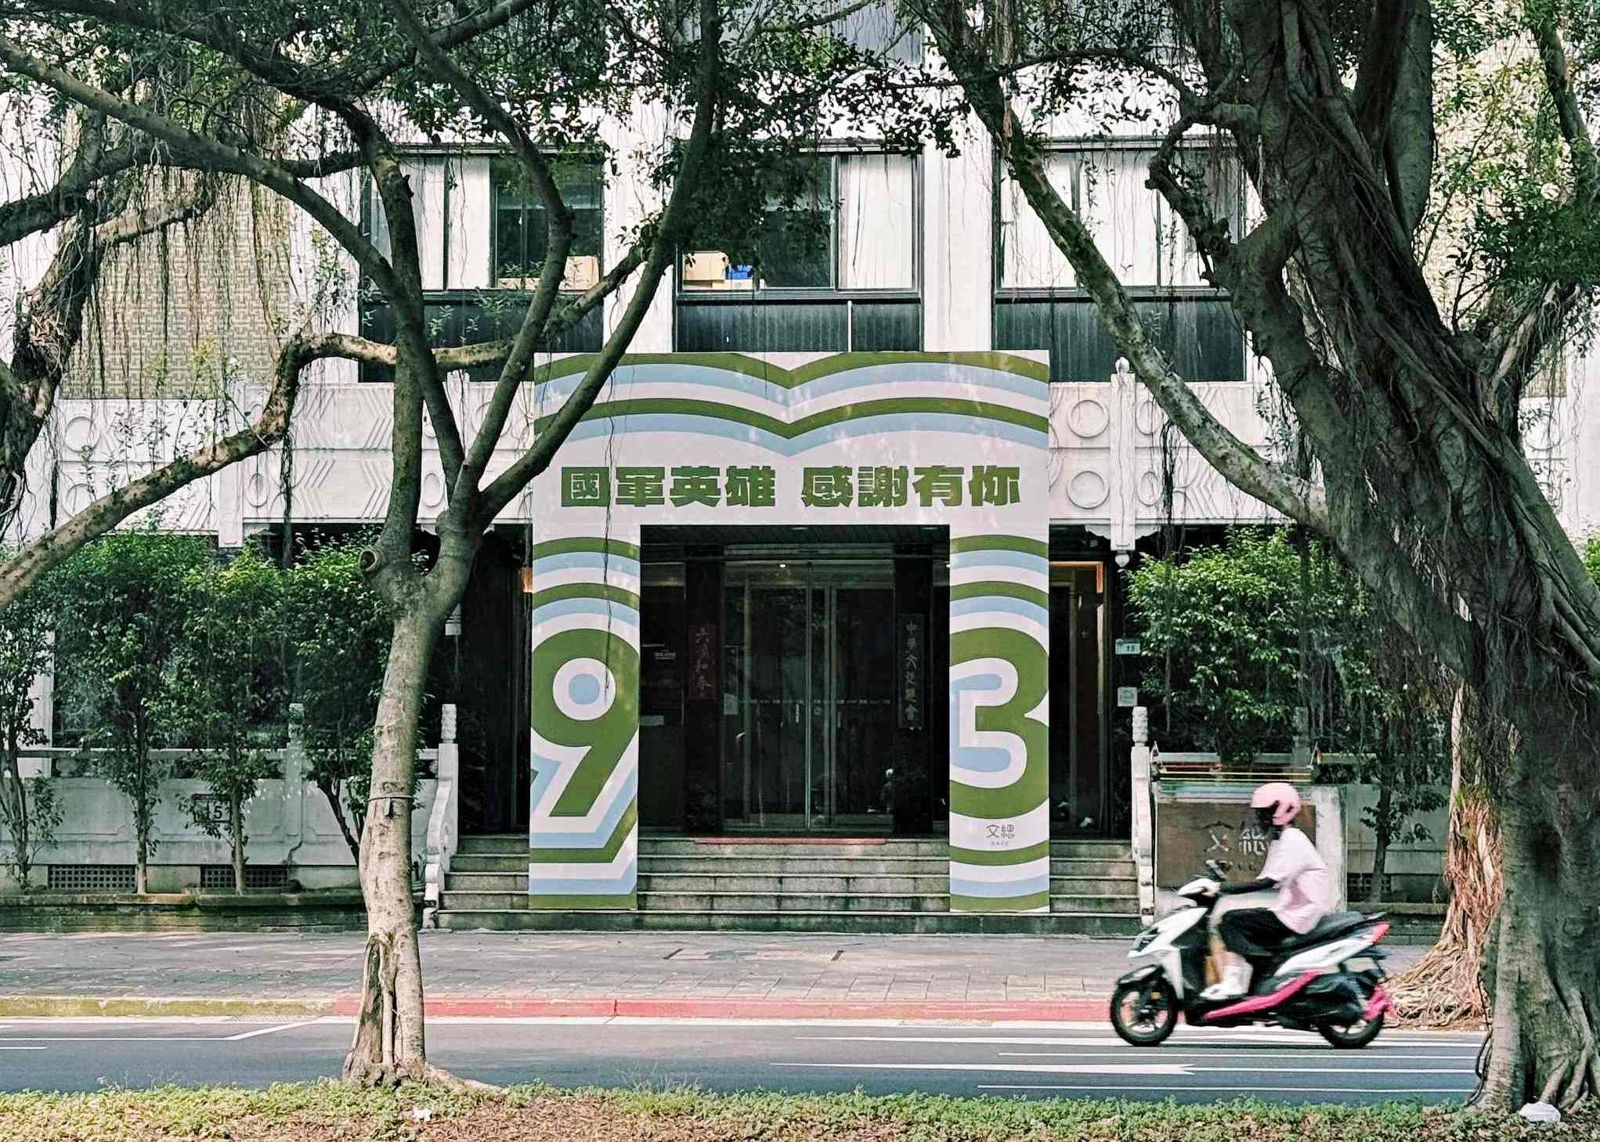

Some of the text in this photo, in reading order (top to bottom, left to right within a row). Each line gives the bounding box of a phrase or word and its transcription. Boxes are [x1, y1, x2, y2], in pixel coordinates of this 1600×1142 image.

[561, 465, 1021, 508] 國軍英雄 感謝有你
[531, 628, 640, 817] 9
[949, 627, 1049, 819] 3
